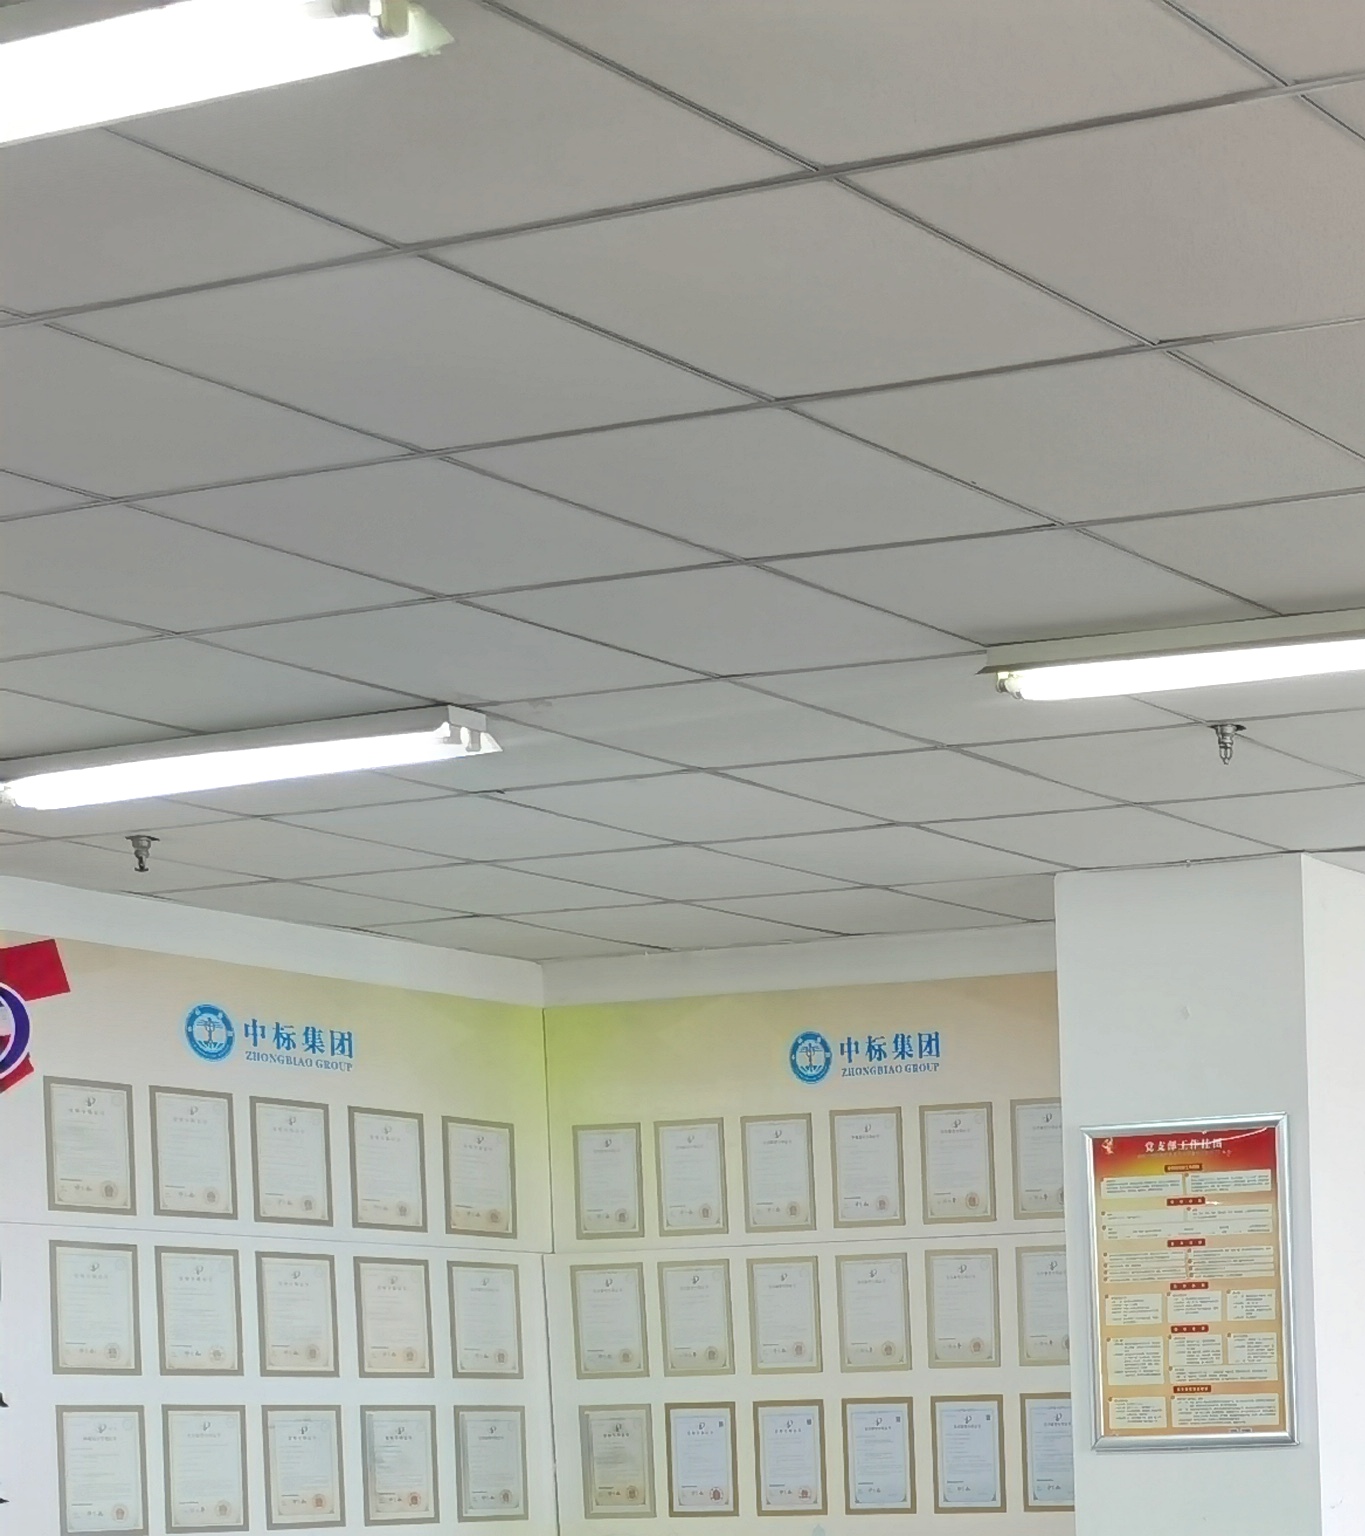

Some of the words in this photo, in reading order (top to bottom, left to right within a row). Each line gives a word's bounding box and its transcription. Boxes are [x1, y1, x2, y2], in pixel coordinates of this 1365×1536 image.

[243, 1018, 354, 1060] 中标集团
[839, 1031, 941, 1064] 中标集团
[245, 1050, 313, 1068] ZHONGBIAO
[315, 1059, 353, 1073] GROUP
[841, 1064, 903, 1077] ZHONGBIAO
[904, 1062, 940, 1073] GROUP
